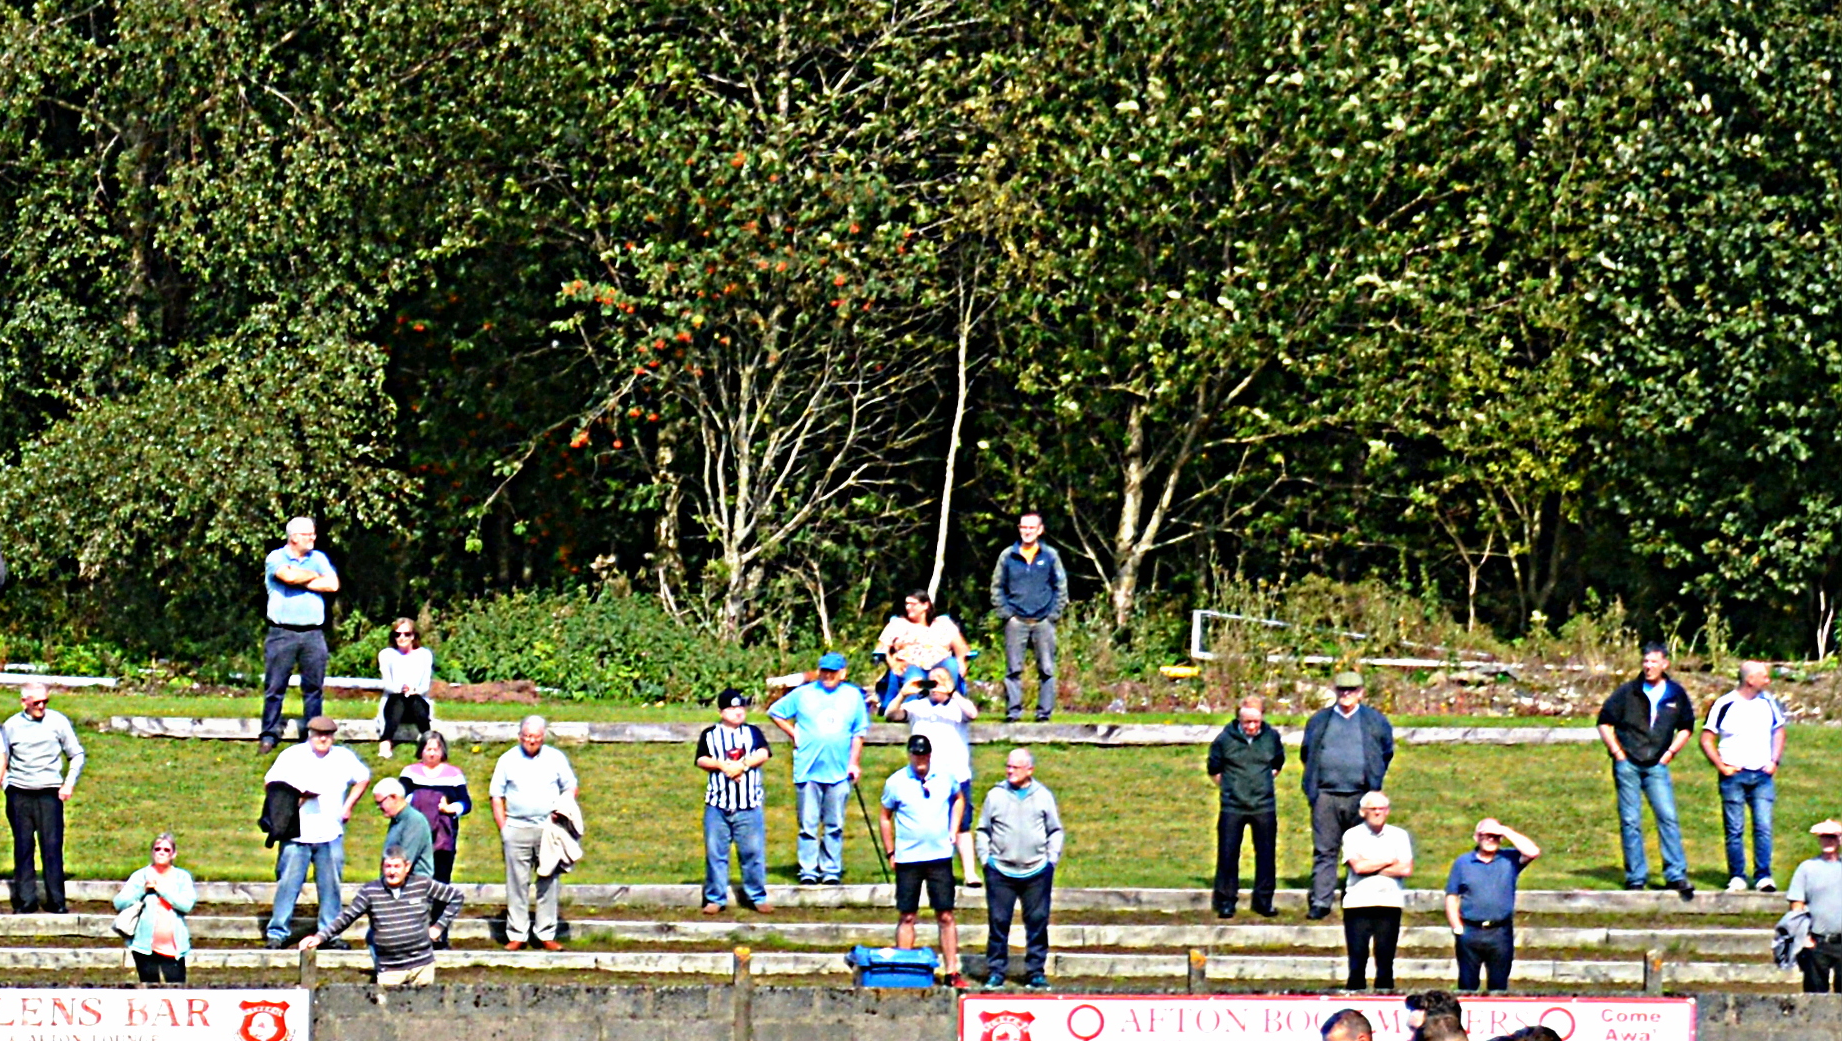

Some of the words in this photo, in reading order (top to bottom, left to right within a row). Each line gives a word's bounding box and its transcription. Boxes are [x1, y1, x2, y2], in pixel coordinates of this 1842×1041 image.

[124, 997, 211, 1028] BAR
[1120, 1008, 1247, 1034] AFTON
[1600, 1008, 1662, 1023] Come
